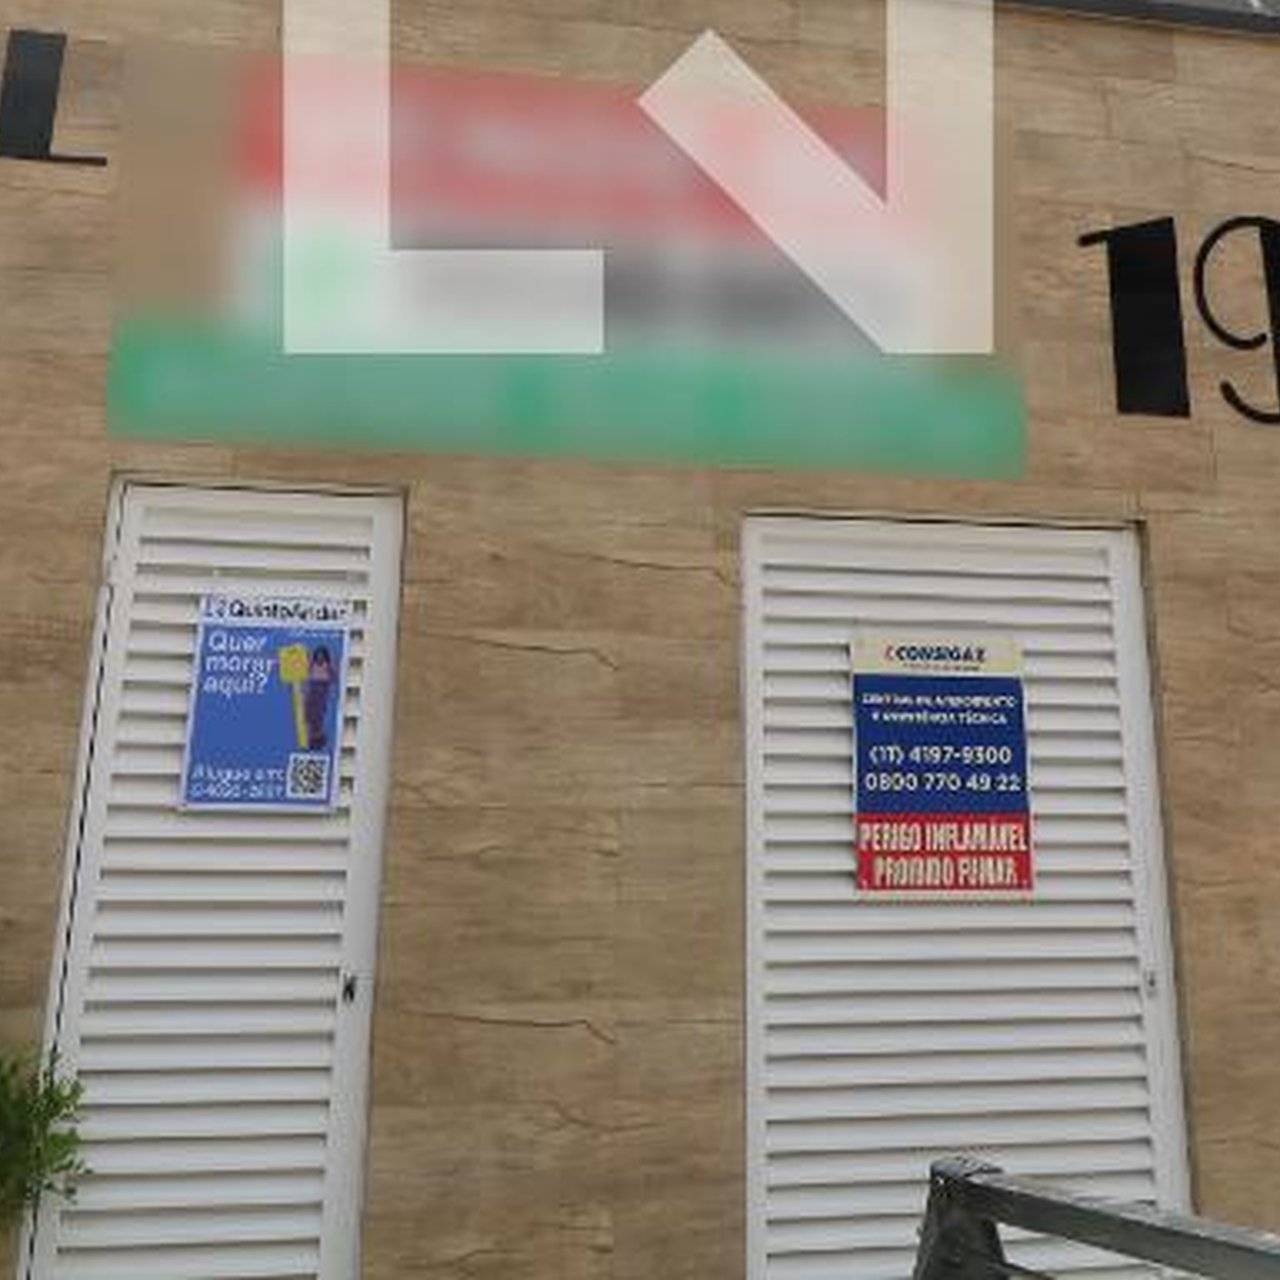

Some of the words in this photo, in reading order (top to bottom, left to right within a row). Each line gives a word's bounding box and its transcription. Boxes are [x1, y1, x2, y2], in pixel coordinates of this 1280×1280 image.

[208, 630, 267, 653] Quer
[206, 654, 271, 674] morar
[203, 673, 268, 699] aqui?
[869, 745, 905, 765] (11)
[865, 772, 918, 791] 0800
[995, 773, 1021, 791] 22
[859, 822, 922, 851] PERIGO
[958, 856, 1018, 887] FUMAR
